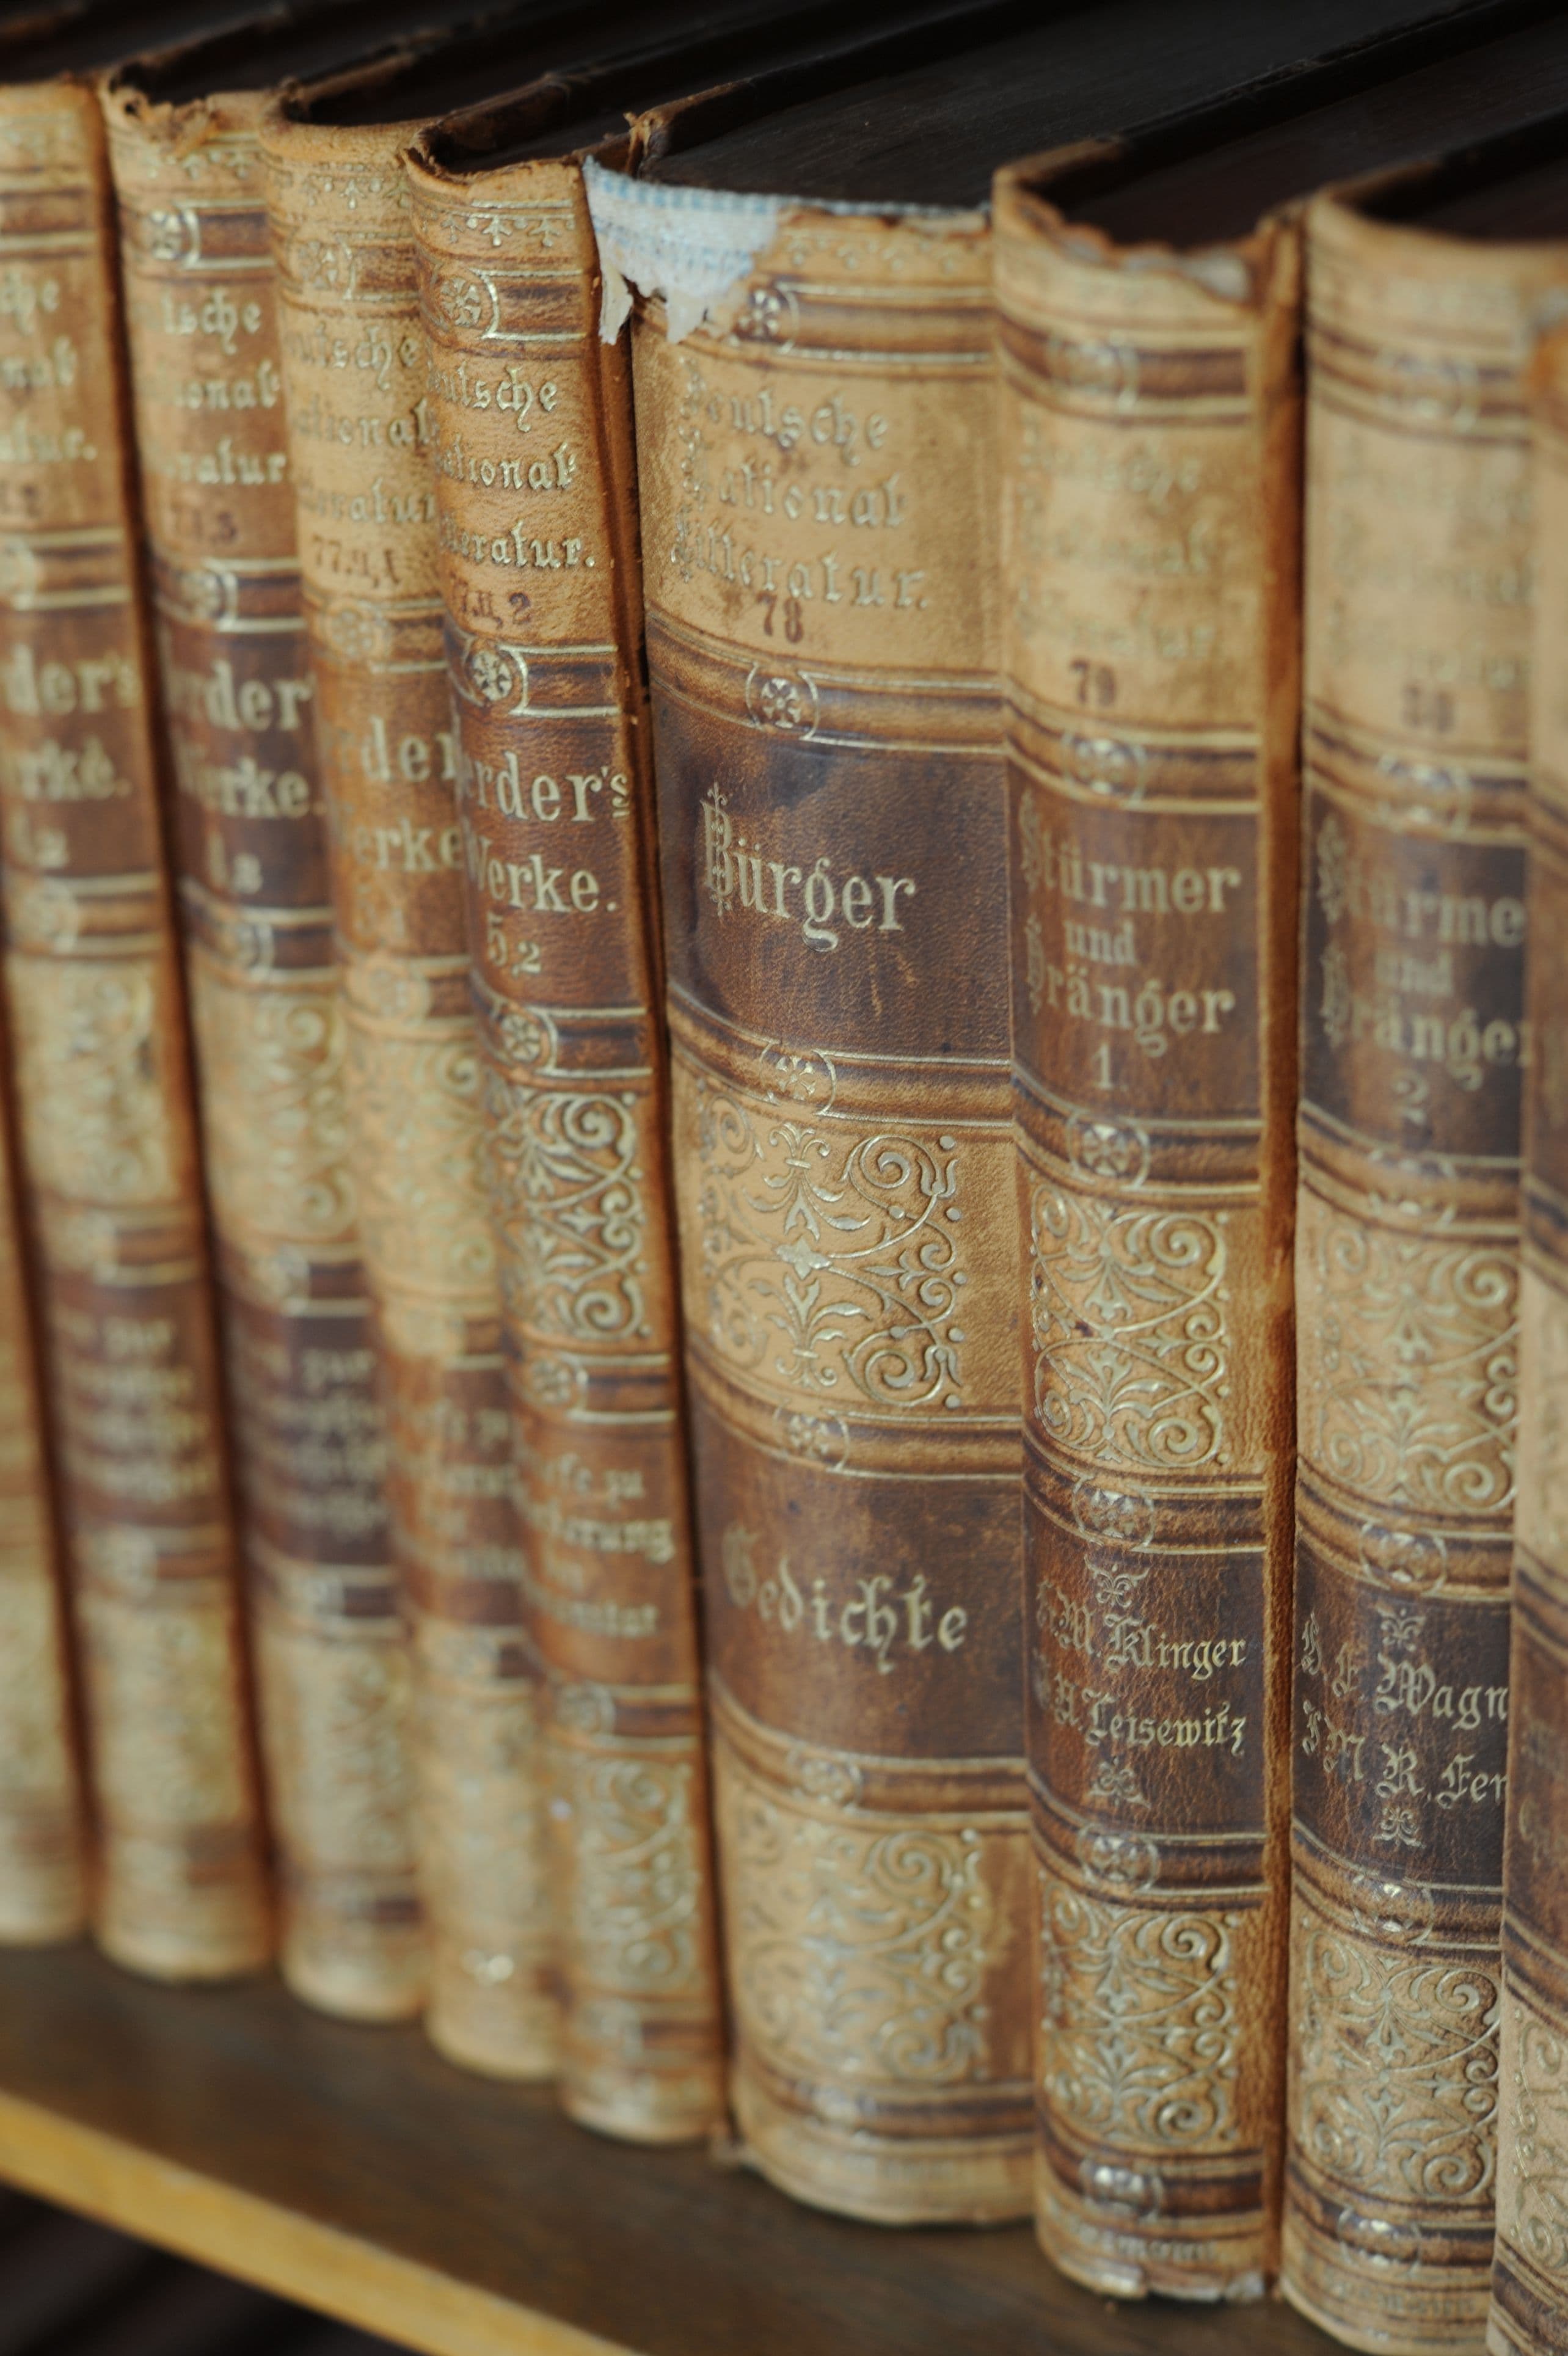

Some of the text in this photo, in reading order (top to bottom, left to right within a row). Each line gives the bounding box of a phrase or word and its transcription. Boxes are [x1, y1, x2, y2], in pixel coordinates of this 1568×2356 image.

[757, 591, 805, 645] 78
[699, 781, 916, 953] Bürger
[1063, 915, 1137, 969] und
[722, 1523, 968, 1676] Gedichte
[1104, 1614, 1246, 1681] Klinger
[1373, 1650, 1509, 1731] Wagn
